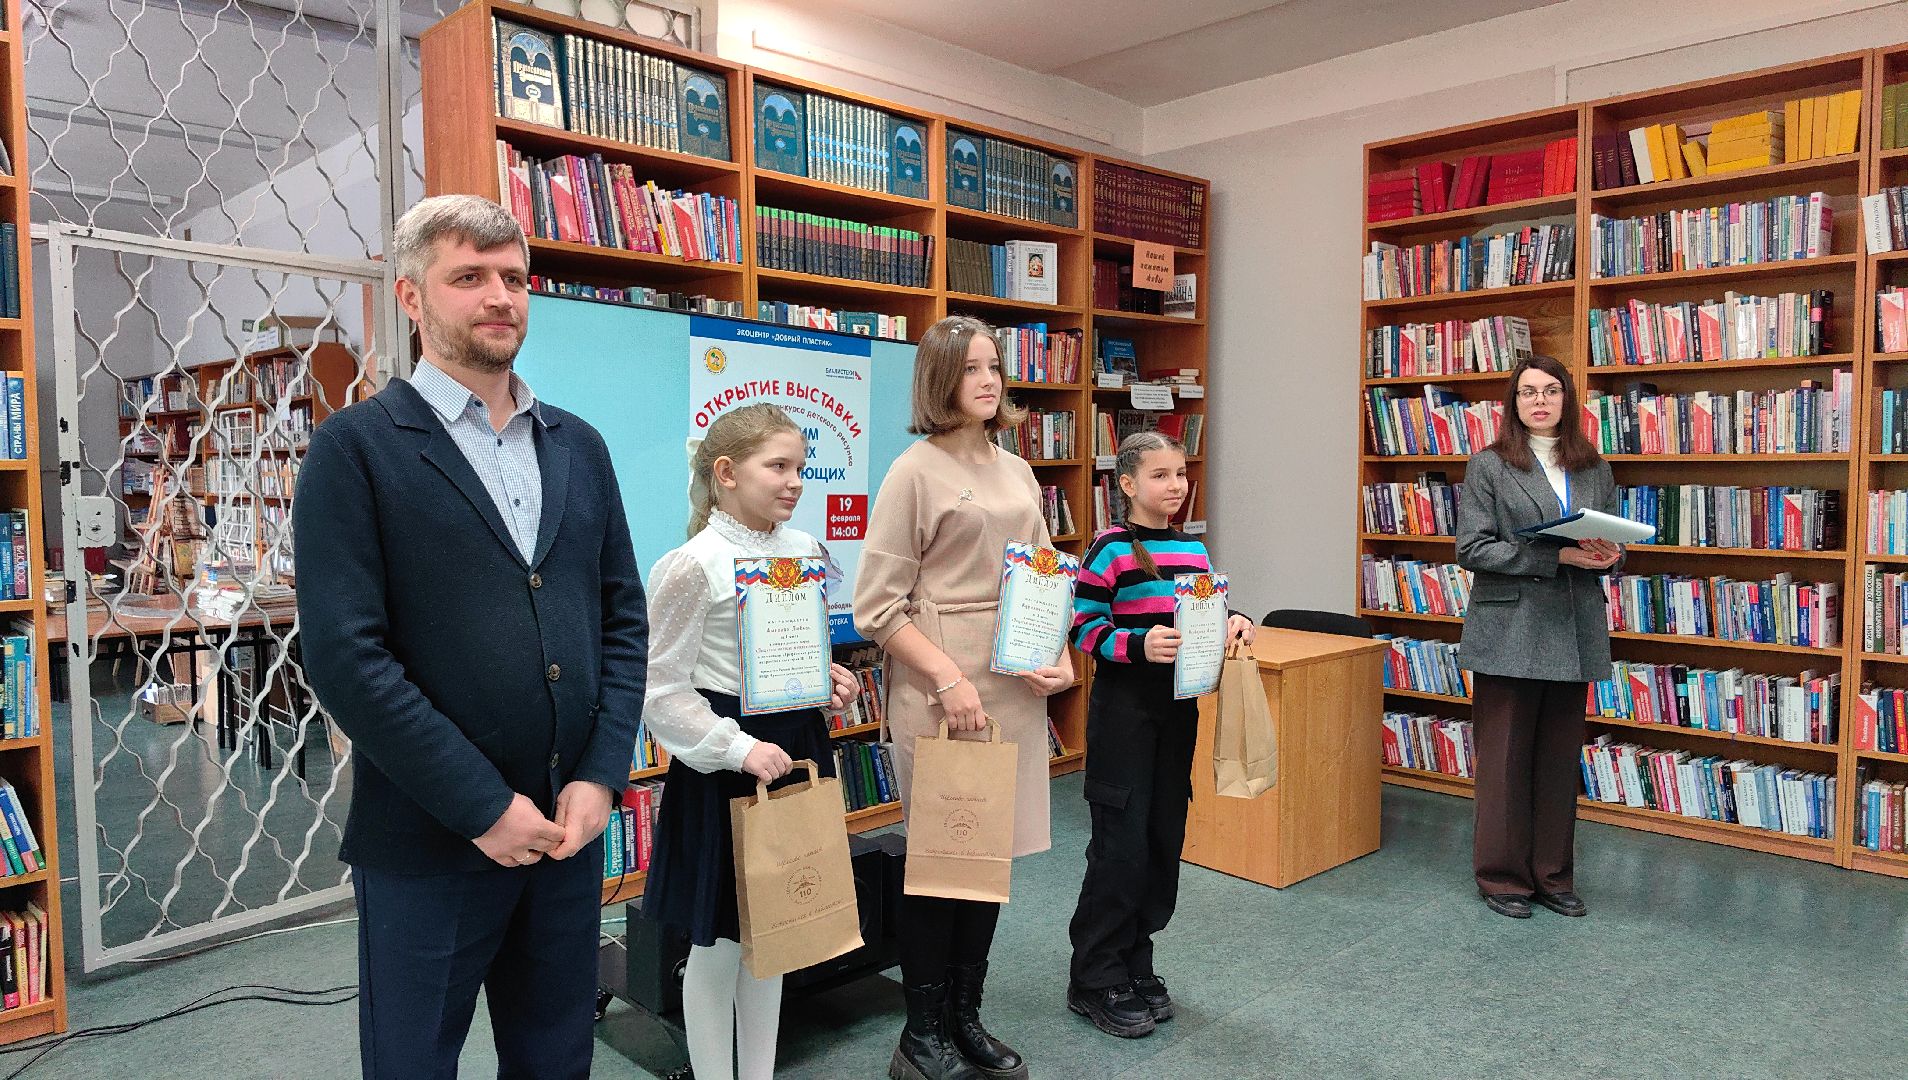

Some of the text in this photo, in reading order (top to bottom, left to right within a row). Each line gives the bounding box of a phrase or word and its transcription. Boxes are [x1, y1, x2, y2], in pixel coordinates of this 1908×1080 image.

[736, 328, 833, 347] ЭКОЦЕНТР «ДОБРЫЙ ПЛАСТИК»
[695, 380, 862, 439] ОТКРЫТИЕ ВЫСТАВКИ
[10, 392, 23, 454] СТРАНЫ МИРА
[806, 411, 837, 433] детского
[836, 432, 854, 467] рисунка
[839, 497, 853, 512] 19
[830, 514, 861, 523] февраля
[831, 526, 859, 537] 14:00
[16, 545, 26, 585] ЗООЛОГИЯ
[798, 888, 812, 898] 110
